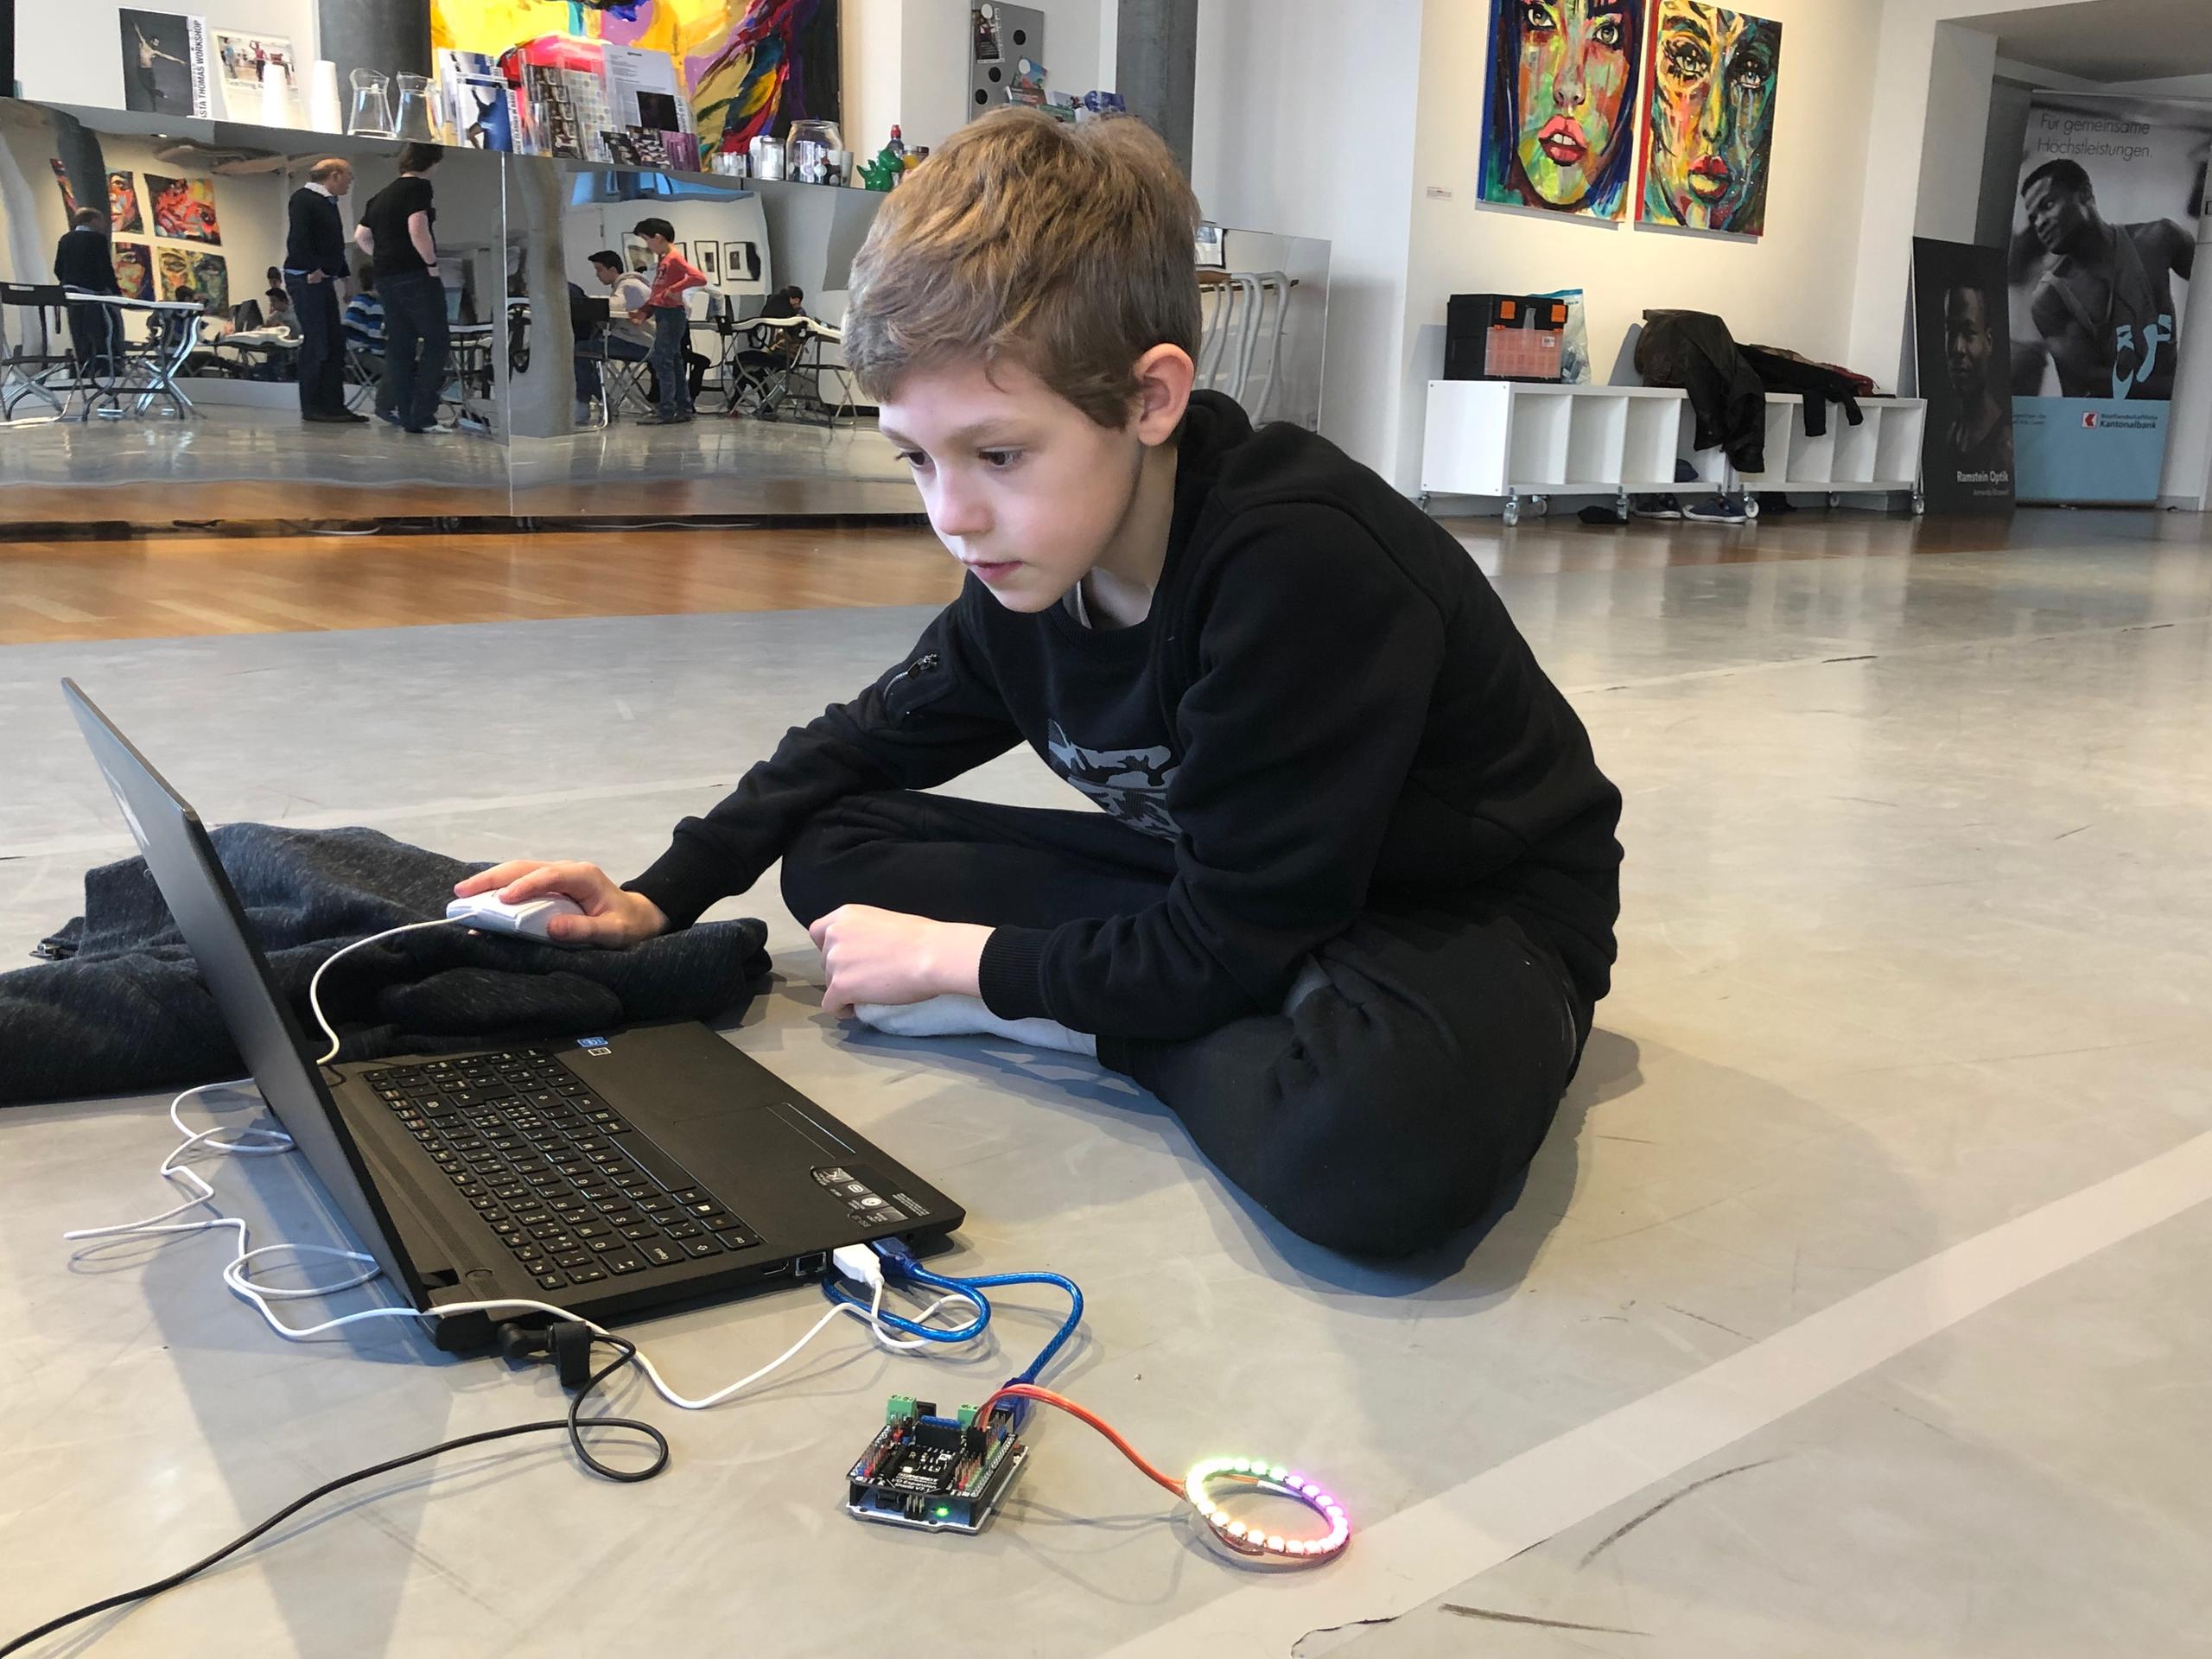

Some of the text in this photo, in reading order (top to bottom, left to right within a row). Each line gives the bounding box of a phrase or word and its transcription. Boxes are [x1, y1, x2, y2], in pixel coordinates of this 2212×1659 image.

[193, 19, 204, 65] WORKSHOP
[196, 66, 207, 99] THOMAS
[2040, 113, 2151, 136] Für gemeinsame
[2037, 137, 2153, 162] Höchstleistungen.
[2100, 421, 2157, 429] Kantonalbank
[1956, 470, 2009, 485] Ramstein Optik
